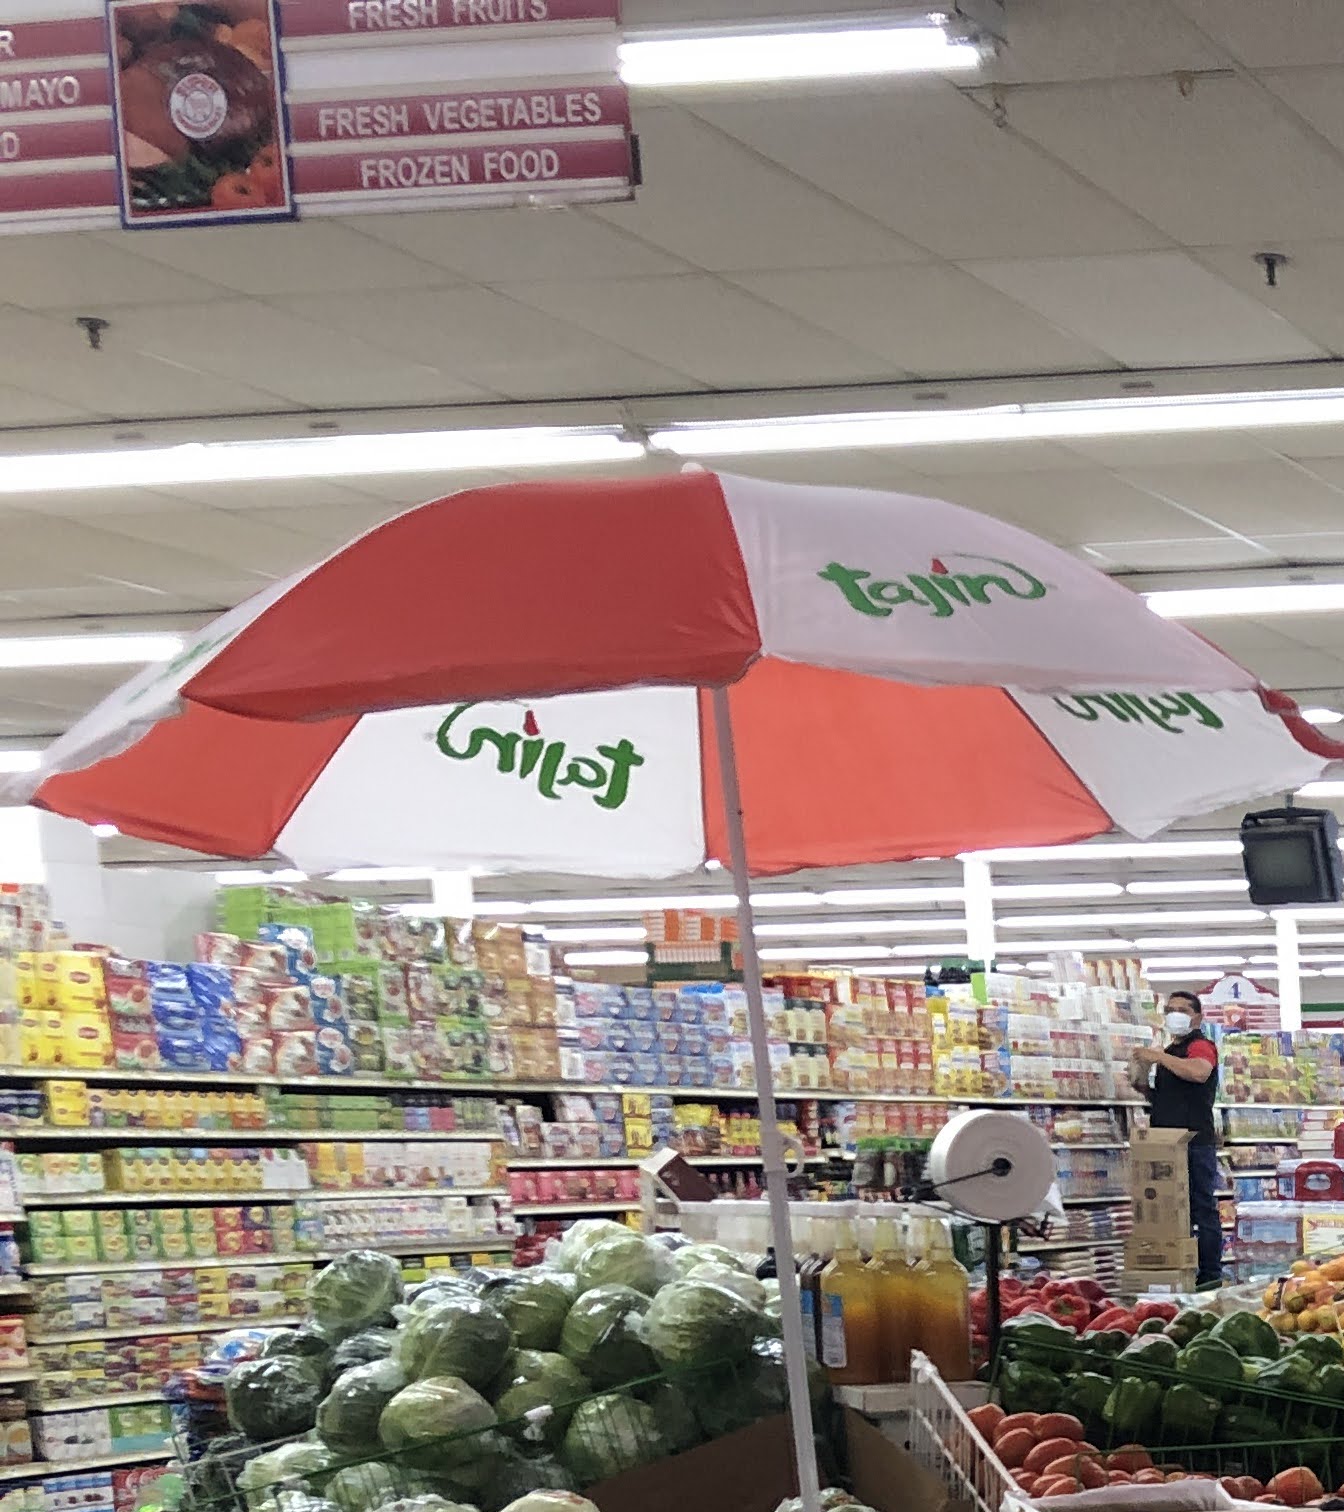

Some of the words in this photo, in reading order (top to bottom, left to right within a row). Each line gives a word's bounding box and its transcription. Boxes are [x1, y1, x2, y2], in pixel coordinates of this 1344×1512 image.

[348, 0, 439, 30] FRESH
[318, 105, 410, 137] FRESH
[423, 92, 601, 131] VEGETABLES
[361, 155, 470, 188] FROZEN
[483, 149, 560, 182] FOOD
